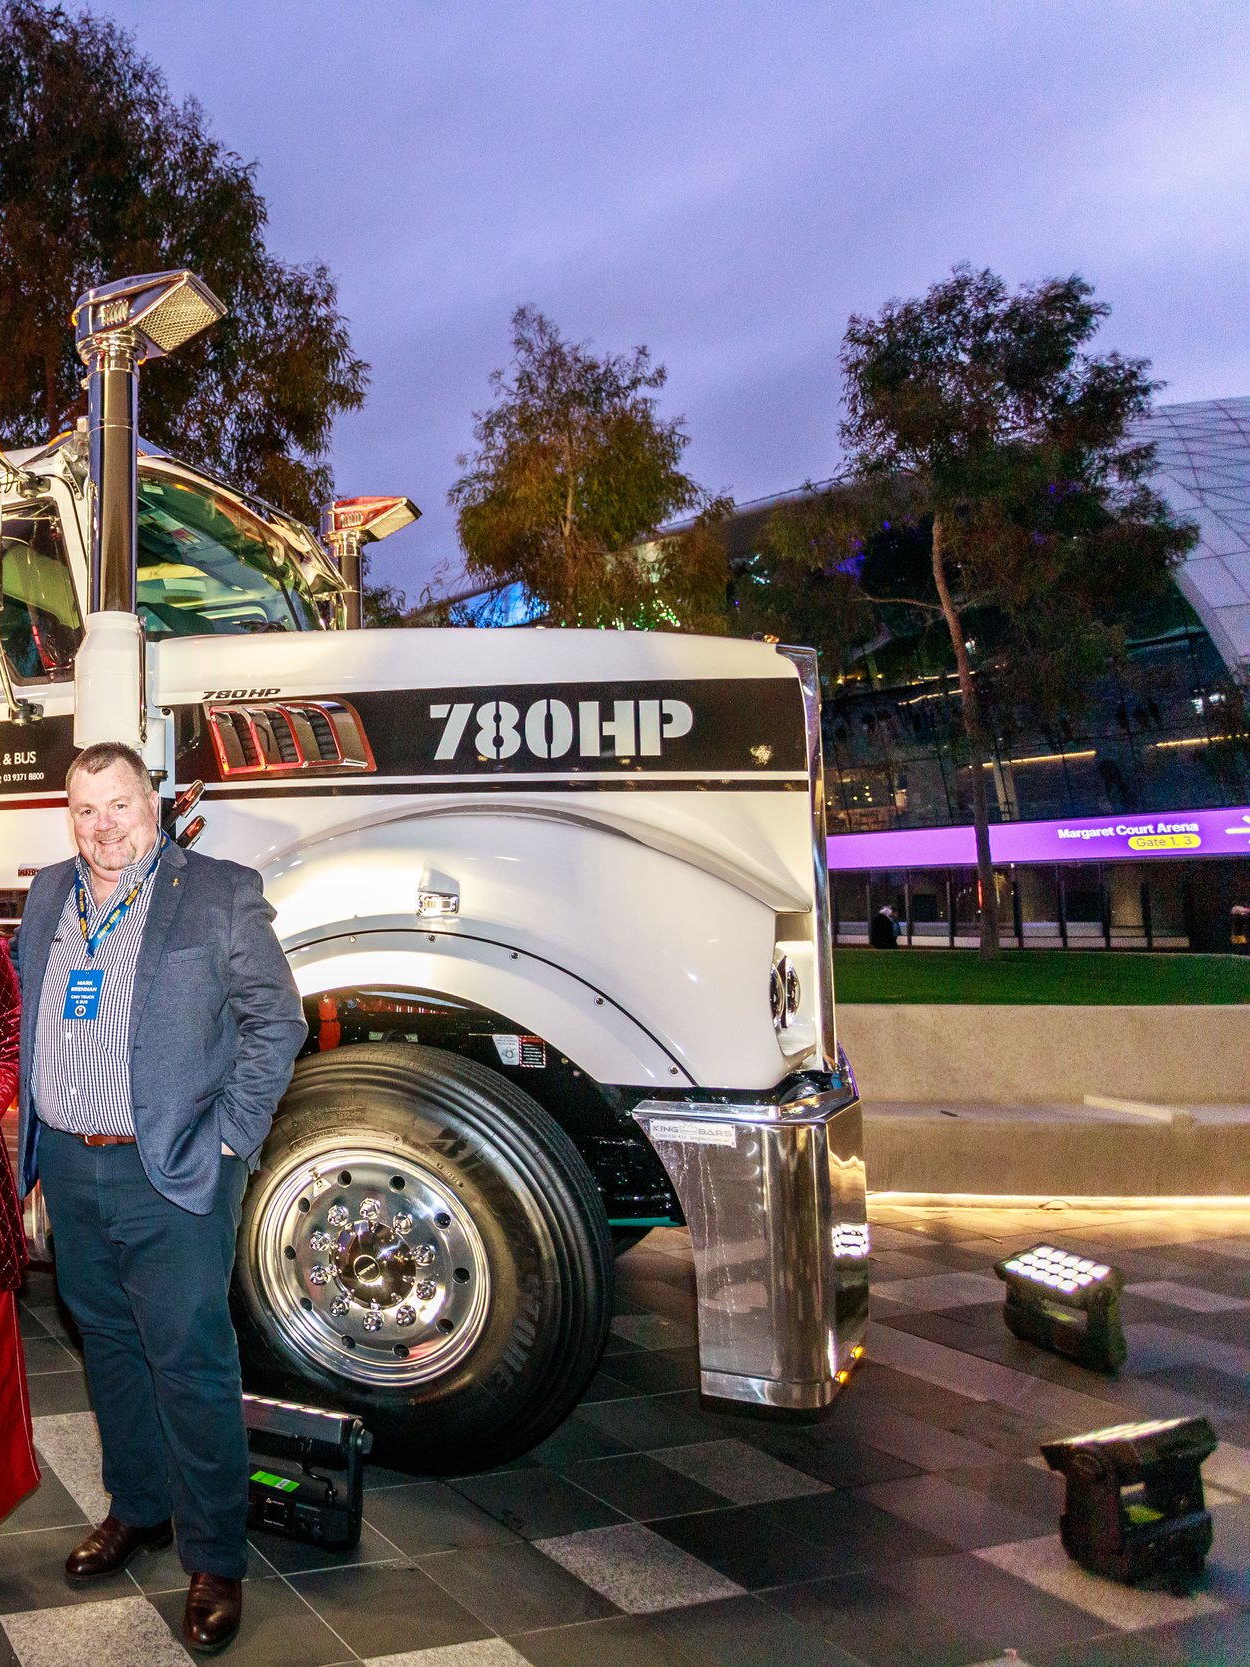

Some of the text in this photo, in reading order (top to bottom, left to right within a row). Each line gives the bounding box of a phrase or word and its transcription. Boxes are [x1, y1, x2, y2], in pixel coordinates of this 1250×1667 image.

[429, 698, 693, 760] 780HP
[3, 753, 12, 765] &
[14, 751, 37, 764] BUS
[3, 774, 11, 782] 03
[12, 773, 27, 781] 9371
[28, 772, 44, 780] 8800
[1057, 822, 1199, 840] Margaret Court Arena
[1136, 837, 1167, 847] Gate
[1184, 835, 1192, 845] 3
[652, 1125, 733, 1137] KING BARS
